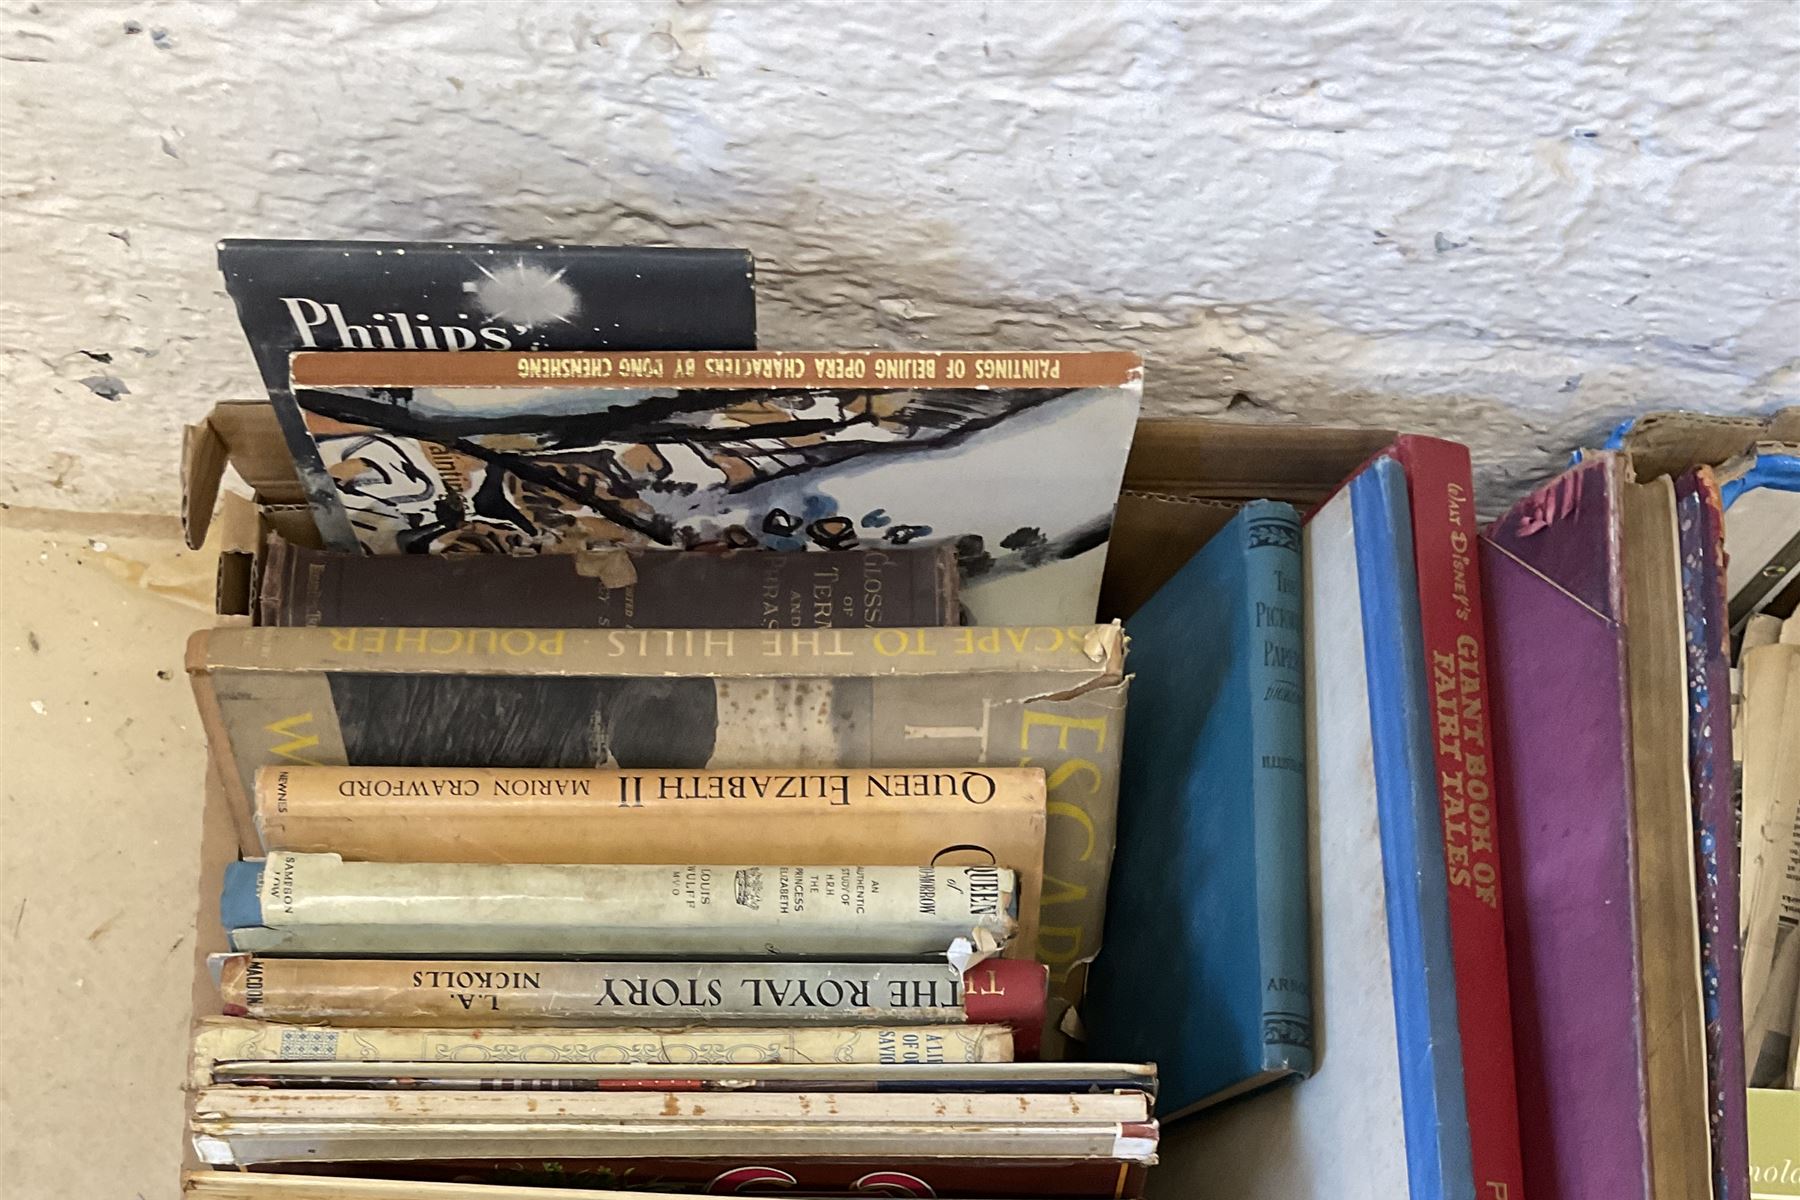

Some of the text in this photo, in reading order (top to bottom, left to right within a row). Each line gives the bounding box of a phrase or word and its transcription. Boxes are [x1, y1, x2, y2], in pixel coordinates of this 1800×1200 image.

[518, 358, 613, 379] CHENSHENG
[675, 359, 696, 380] BY
[705, 359, 806, 380] CHARACTERS
[815, 359, 866, 380] OPERA
[875, 359, 937, 380] BEIJING
[945, 359, 966, 380] OF
[976, 359, 1060, 380] PAINTINGS
[863, 552, 897, 628] GLOSS
[330, 626, 1086, 657] SCAPE TO THE HILLS POUCHER
[1457, 635, 1484, 747] GIANT
[1433, 650, 1471, 887] FAIRY TALES
[277, 771, 289, 813] NEWNES
[339, 772, 997, 808] QUEEN ELIZABETH II MARION CRAWFORD
[1466, 752, 1492, 853] BOOK
[685, 866, 696, 909] WULFF
[700, 868, 711, 904] LOUIS
[779, 867, 789, 914] ELIZABETH
[794, 868, 804, 912] PRINCESS
[810, 875, 819, 893] THE
[841, 868, 850, 906] STUDY OF
[856, 866, 864, 914] AUTHENTIC
[871, 880, 879, 893] AN
[947, 879, 964, 894] of
[964, 866, 999, 916] QUEEN
[1473, 862, 1496, 908] OF
[413, 971, 540, 989] NICKOLLS
[596, 978, 965, 1008] THE ROYAL STORY
[450, 994, 500, 1009] L.A.
[903, 1034, 919, 1049] OF
